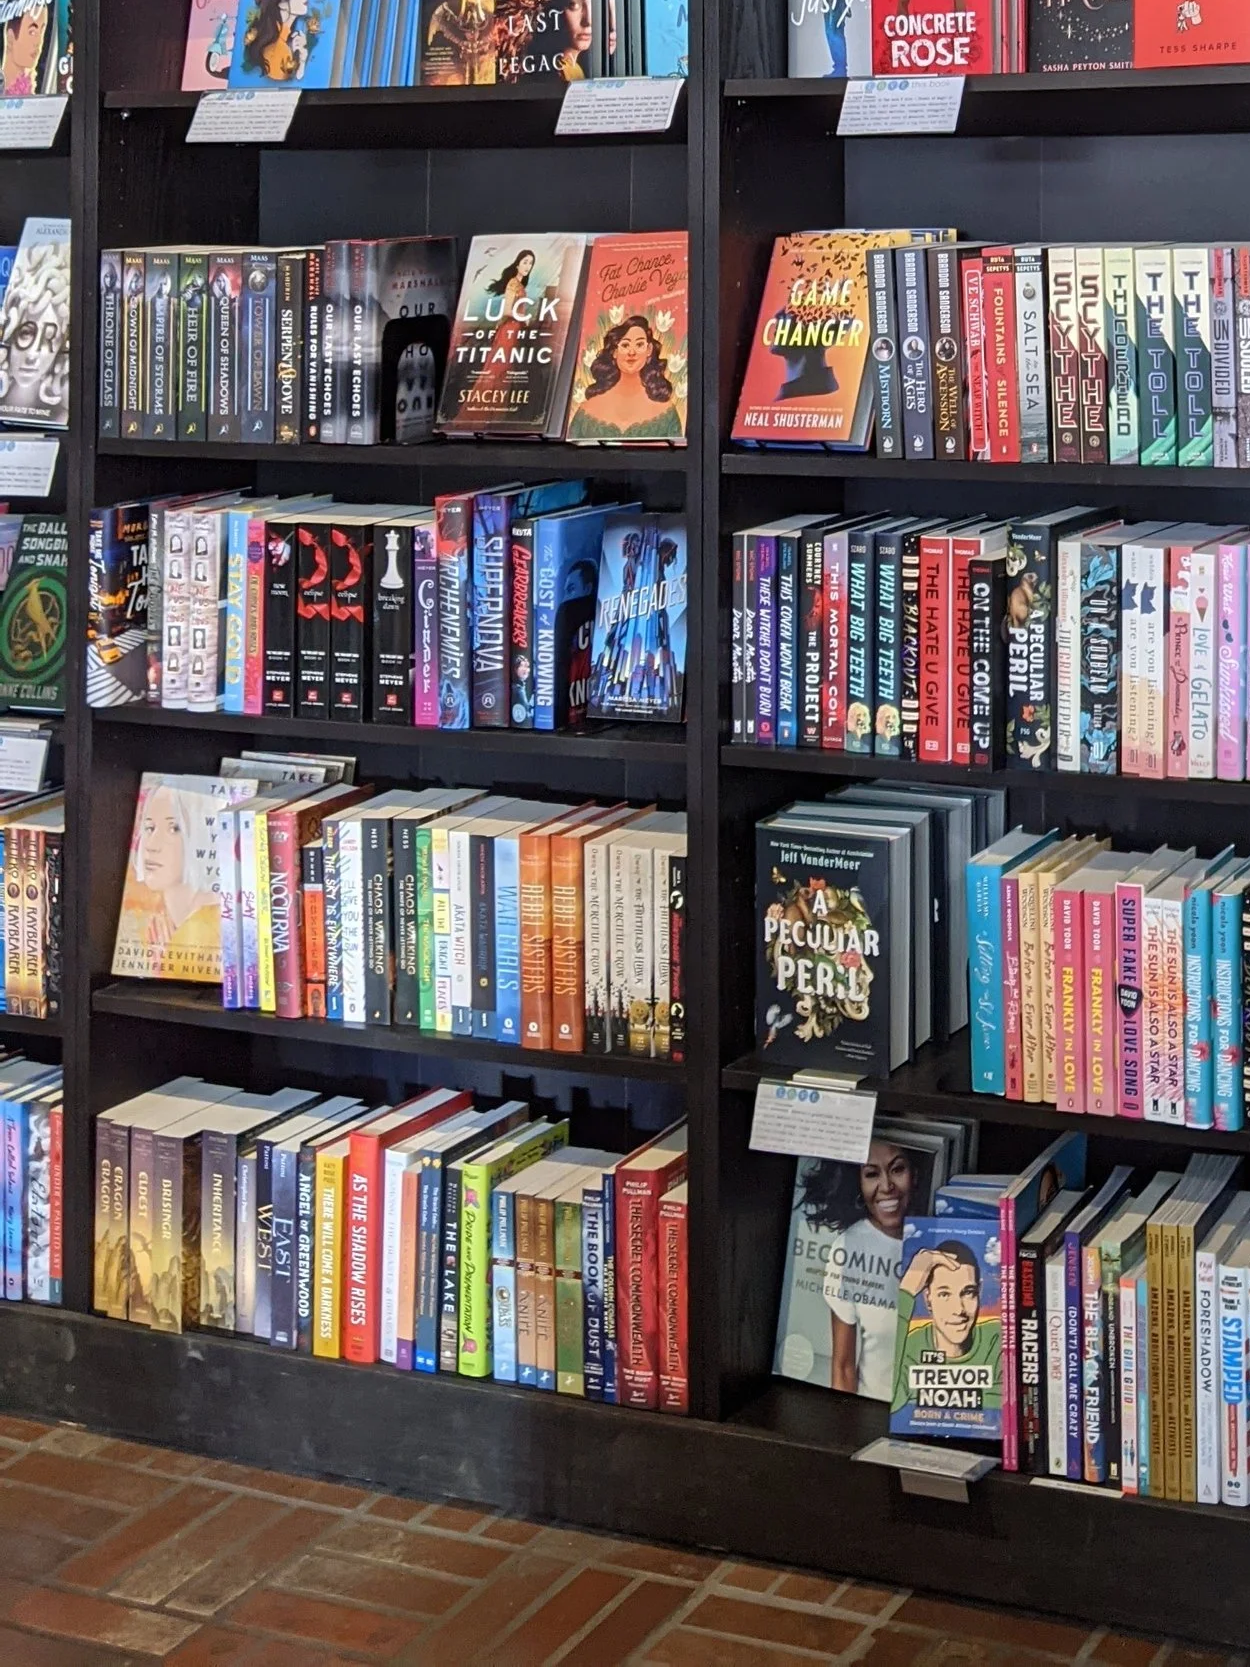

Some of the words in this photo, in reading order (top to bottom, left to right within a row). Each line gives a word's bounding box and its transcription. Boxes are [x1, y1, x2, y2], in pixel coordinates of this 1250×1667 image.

[508, 9, 564, 36] LAST
[884, 12, 976, 37] CONCRETE
[499, 52, 578, 76] LEGACY
[891, 38, 970, 68] ROSE
[1159, 45, 1186, 53] TESS
[1192, 42, 1237, 52] SHARPE
[600, 264, 623, 282] Fat
[873, 254, 886, 289] BRANDON
[463, 297, 561, 322] LUCK
[790, 279, 854, 307] GAME
[875, 290, 888, 334] SANDERSON
[993, 287, 1006, 366] FOUNTAINS
[475, 330, 497, 340] OF
[507, 330, 537, 340] THE
[762, 318, 864, 347] CHANGER
[1023, 310, 1038, 359] SALT
[1053, 271, 1077, 429] SCYTHE
[456, 347, 552, 364] TITANIC
[458, 390, 507, 404] STACEY
[510, 390, 530, 404] LEE
[997, 380, 1009, 437] SILENCE
[1026, 370, 1040, 410] SEA
[744, 413, 770, 427] NEAL
[773, 412, 844, 429] SHUSTERMAN
[539, 566, 555, 611] COST
[830, 563, 839, 601] THIS
[851, 562, 865, 611] WHAT
[476, 536, 503, 674] SUPERNOVA
[598, 574, 687, 628] RENEGADES
[808, 631, 817, 647] THE
[829, 609, 839, 681] MORTAL
[850, 615, 865, 642] BIG
[536, 626, 554, 707] KNOWING
[850, 647, 865, 698] TEETH
[806, 652, 819, 723] PROJECT
[829, 686, 837, 726] COIL
[282, 770, 315, 783] TAKE
[325, 856, 335, 874] THE
[781, 850, 798, 865] Jeff
[800, 853, 861, 871] VanderMeer
[325, 879, 337, 899] SKY
[374, 874, 383, 915] CHAOS
[521, 884, 544, 927] REBEL
[813, 889, 828, 916] A
[270, 871, 290, 954] NOCTURNA
[1122, 899, 1136, 942] SUPER
[118, 946, 153, 958] DAVID
[159, 948, 223, 963] LEVITHAN
[326, 919, 338, 987] EVERYWHERE
[375, 920, 384, 975] WALKING
[764, 917, 880, 957] PECULIAR
[116, 960, 174, 973] JENNIFER
[182, 964, 221, 975] NIVEN
[523, 933, 546, 995] SISTERS
[777, 956, 868, 1002] PERIL
[1123, 949, 1137, 982] FAKE
[1124, 1020, 1137, 1053] LOVE
[1124, 1060, 1138, 1096] SONG
[352, 1174, 368, 1193] AS
[162, 1179, 172, 1239] BRISINGR
[352, 1195, 367, 1222] THE
[352, 1225, 367, 1284] SHADOW
[351, 1287, 366, 1325] RISES
[795, 1278, 849, 1301] MICHELLE
[852, 1292, 896, 1311] OBAMA
[921, 1350, 945, 1364] IT'S
[1022, 1319, 1038, 1384] RACERS
[1200, 1289, 1212, 1394] FORESHADOW
[912, 1369, 990, 1386] TREVOR
[1222, 1316, 1244, 1406] STAMPED
[919, 1389, 983, 1408] NOAH:
[1086, 1387, 1100, 1444] FRIEND
